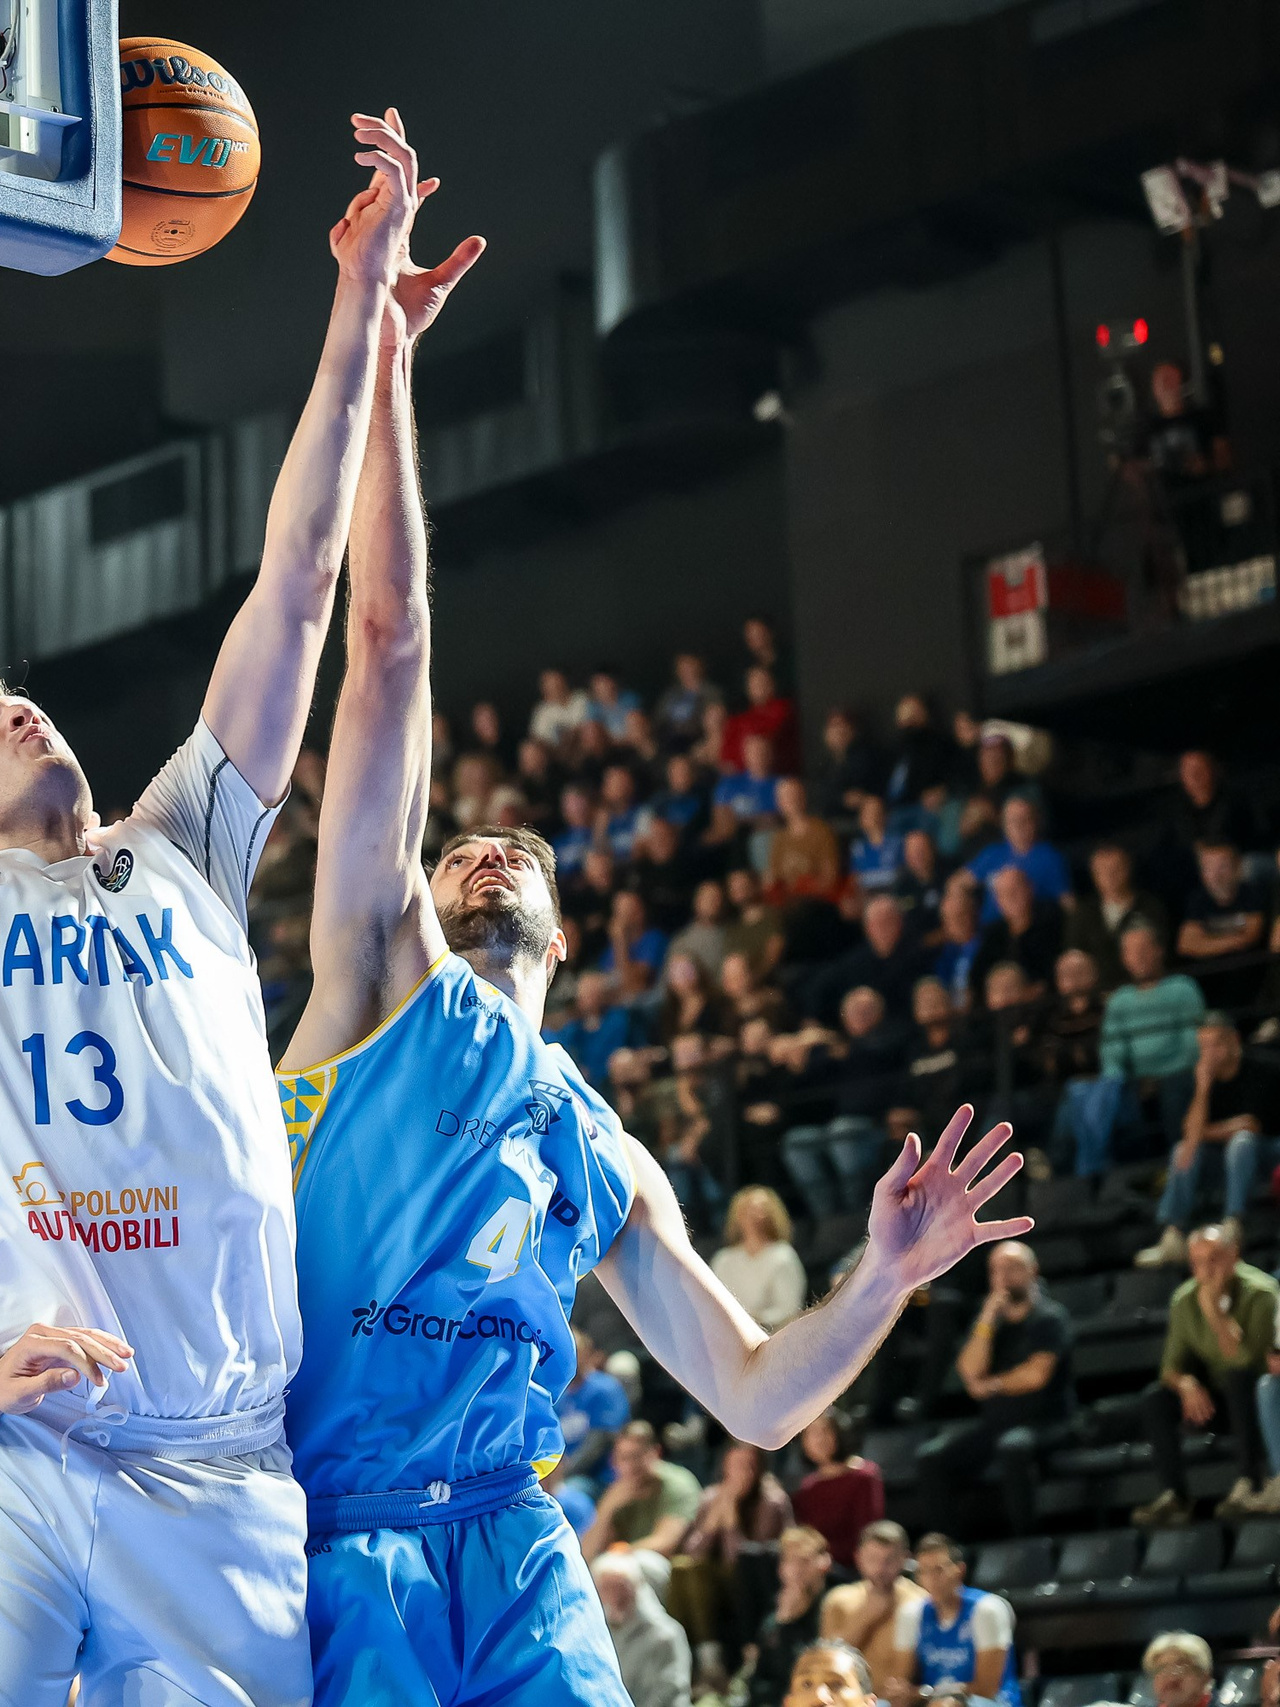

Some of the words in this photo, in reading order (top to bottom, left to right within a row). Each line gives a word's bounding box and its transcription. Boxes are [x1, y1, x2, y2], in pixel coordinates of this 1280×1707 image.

[146, 132, 232, 168] EVO
[22, 1030, 124, 1126] 13
[70, 1185, 179, 1217] POLOVNI
[27, 1210, 180, 1253] AUTMOBILI
[465, 1196, 533, 1284] 4
